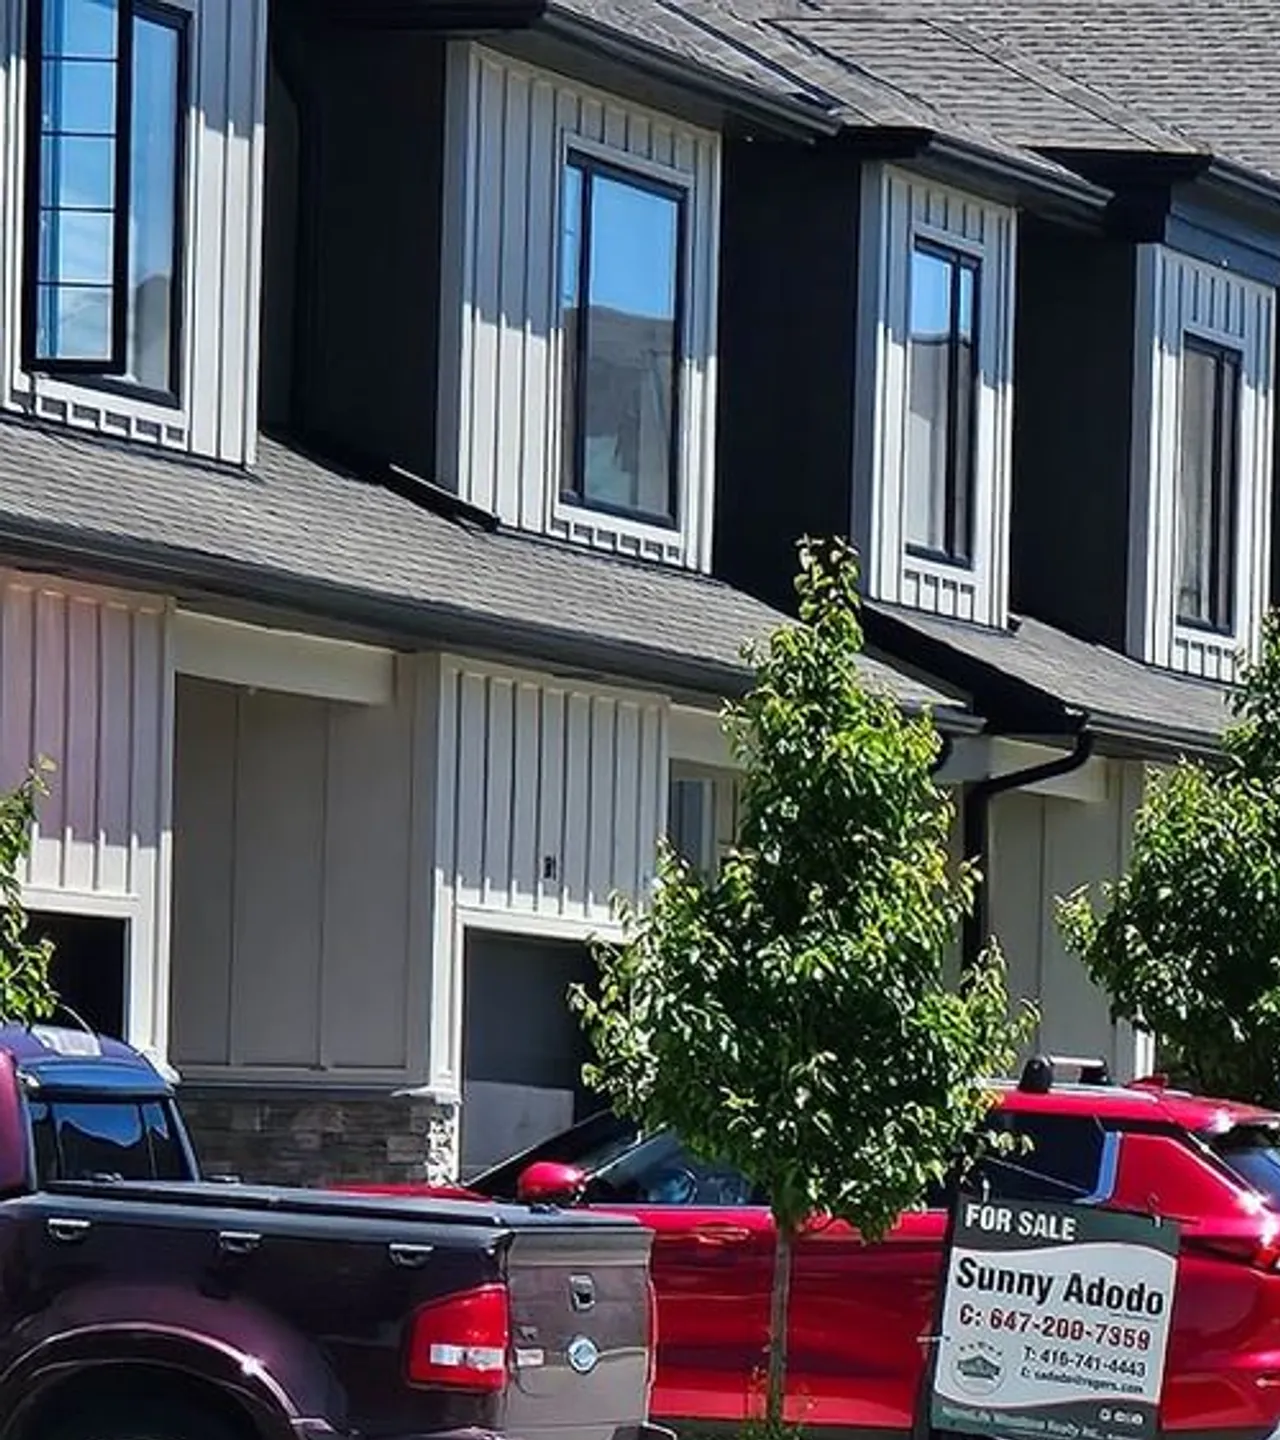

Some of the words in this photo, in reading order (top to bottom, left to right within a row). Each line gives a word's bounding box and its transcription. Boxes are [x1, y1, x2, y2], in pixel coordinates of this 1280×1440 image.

[965, 1203, 1012, 1233] FOR
[1018, 1211, 1077, 1241] SALE
[957, 1257, 1053, 1305] Sunny
[1063, 1273, 1164, 1315] Adodo
[960, 1303, 981, 1327] C:
